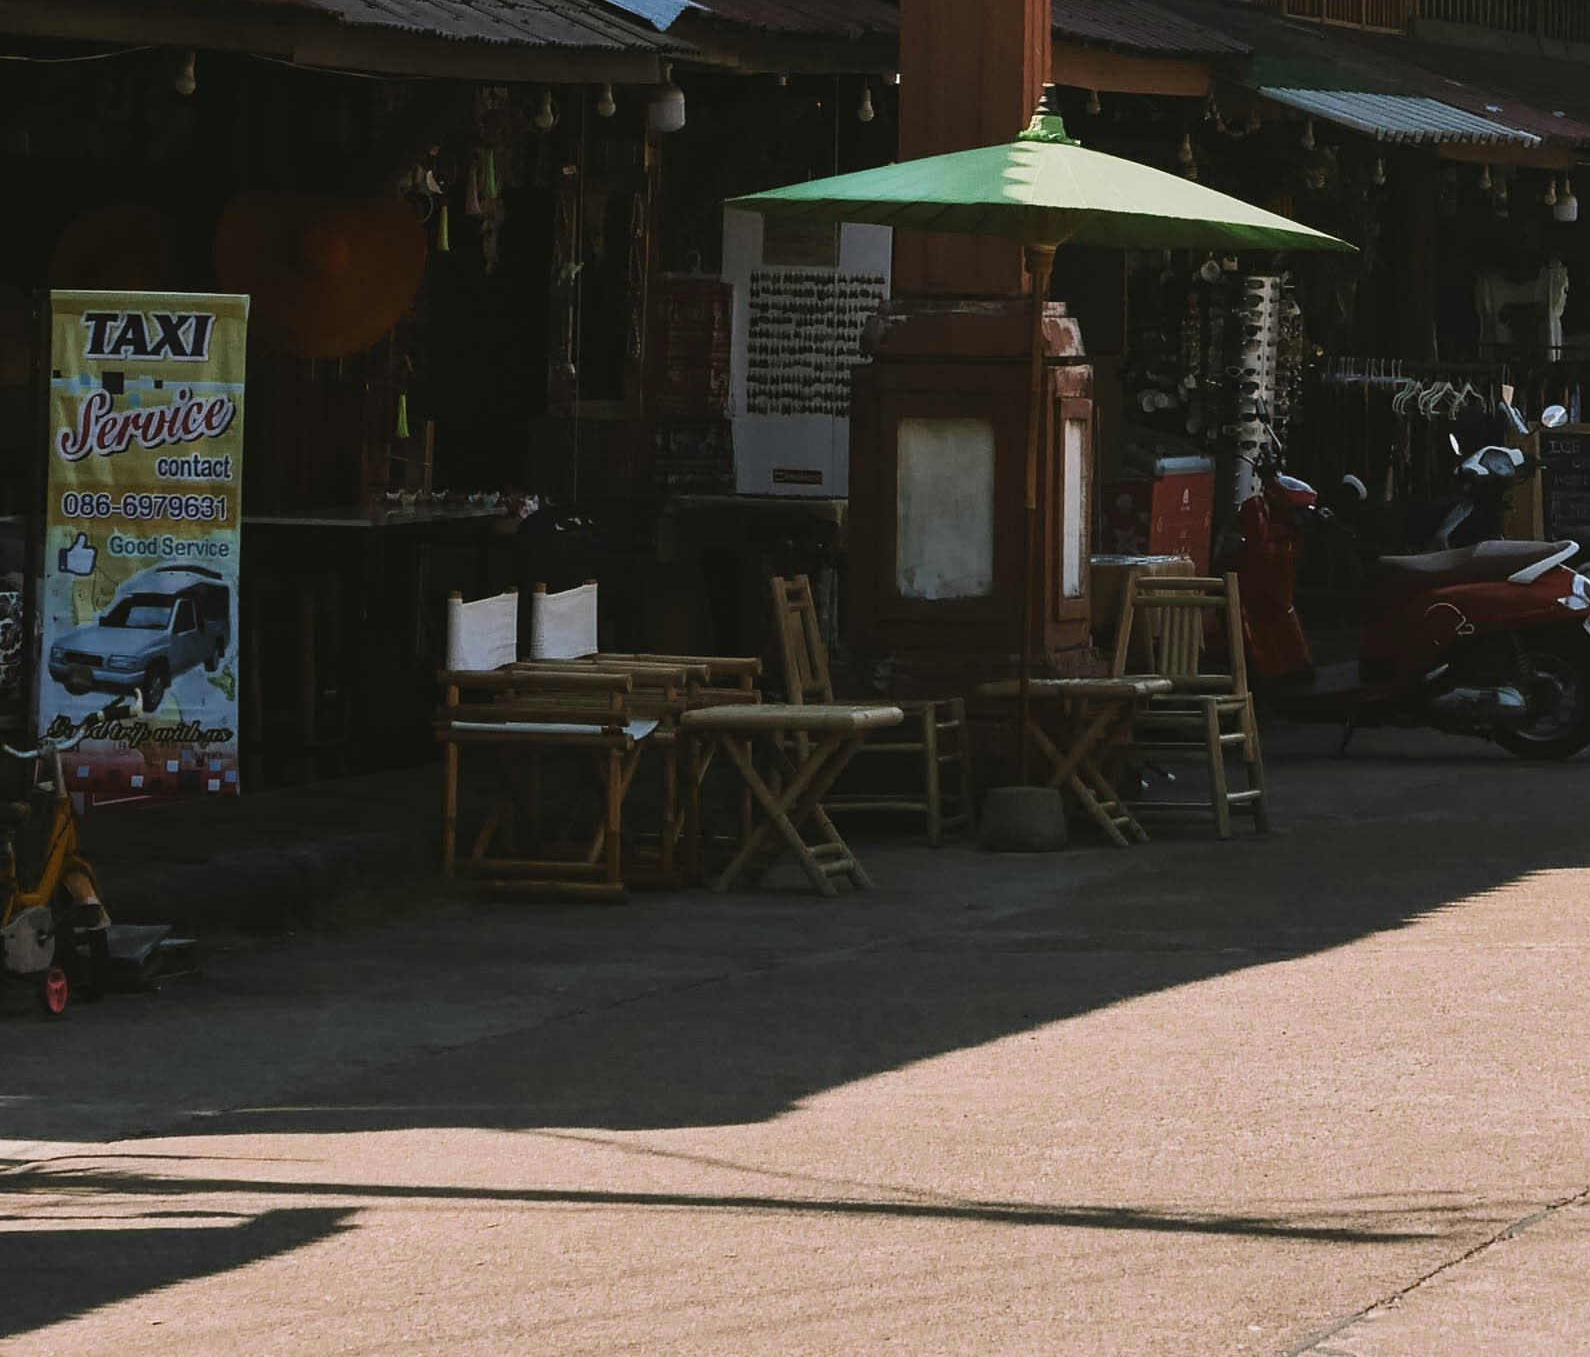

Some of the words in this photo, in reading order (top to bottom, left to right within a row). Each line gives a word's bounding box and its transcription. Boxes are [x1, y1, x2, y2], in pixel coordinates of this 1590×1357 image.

[82, 311, 215, 360] TAXI
[58, 388, 233, 459] Service
[157, 454, 232, 479] contact
[62, 492, 228, 520] 086-6979631
[110, 536, 157, 555] Good
[162, 537, 230, 557] Service
[110, 720, 151, 748] trip
[153, 721, 201, 742] with
[206, 727, 232, 742] us
